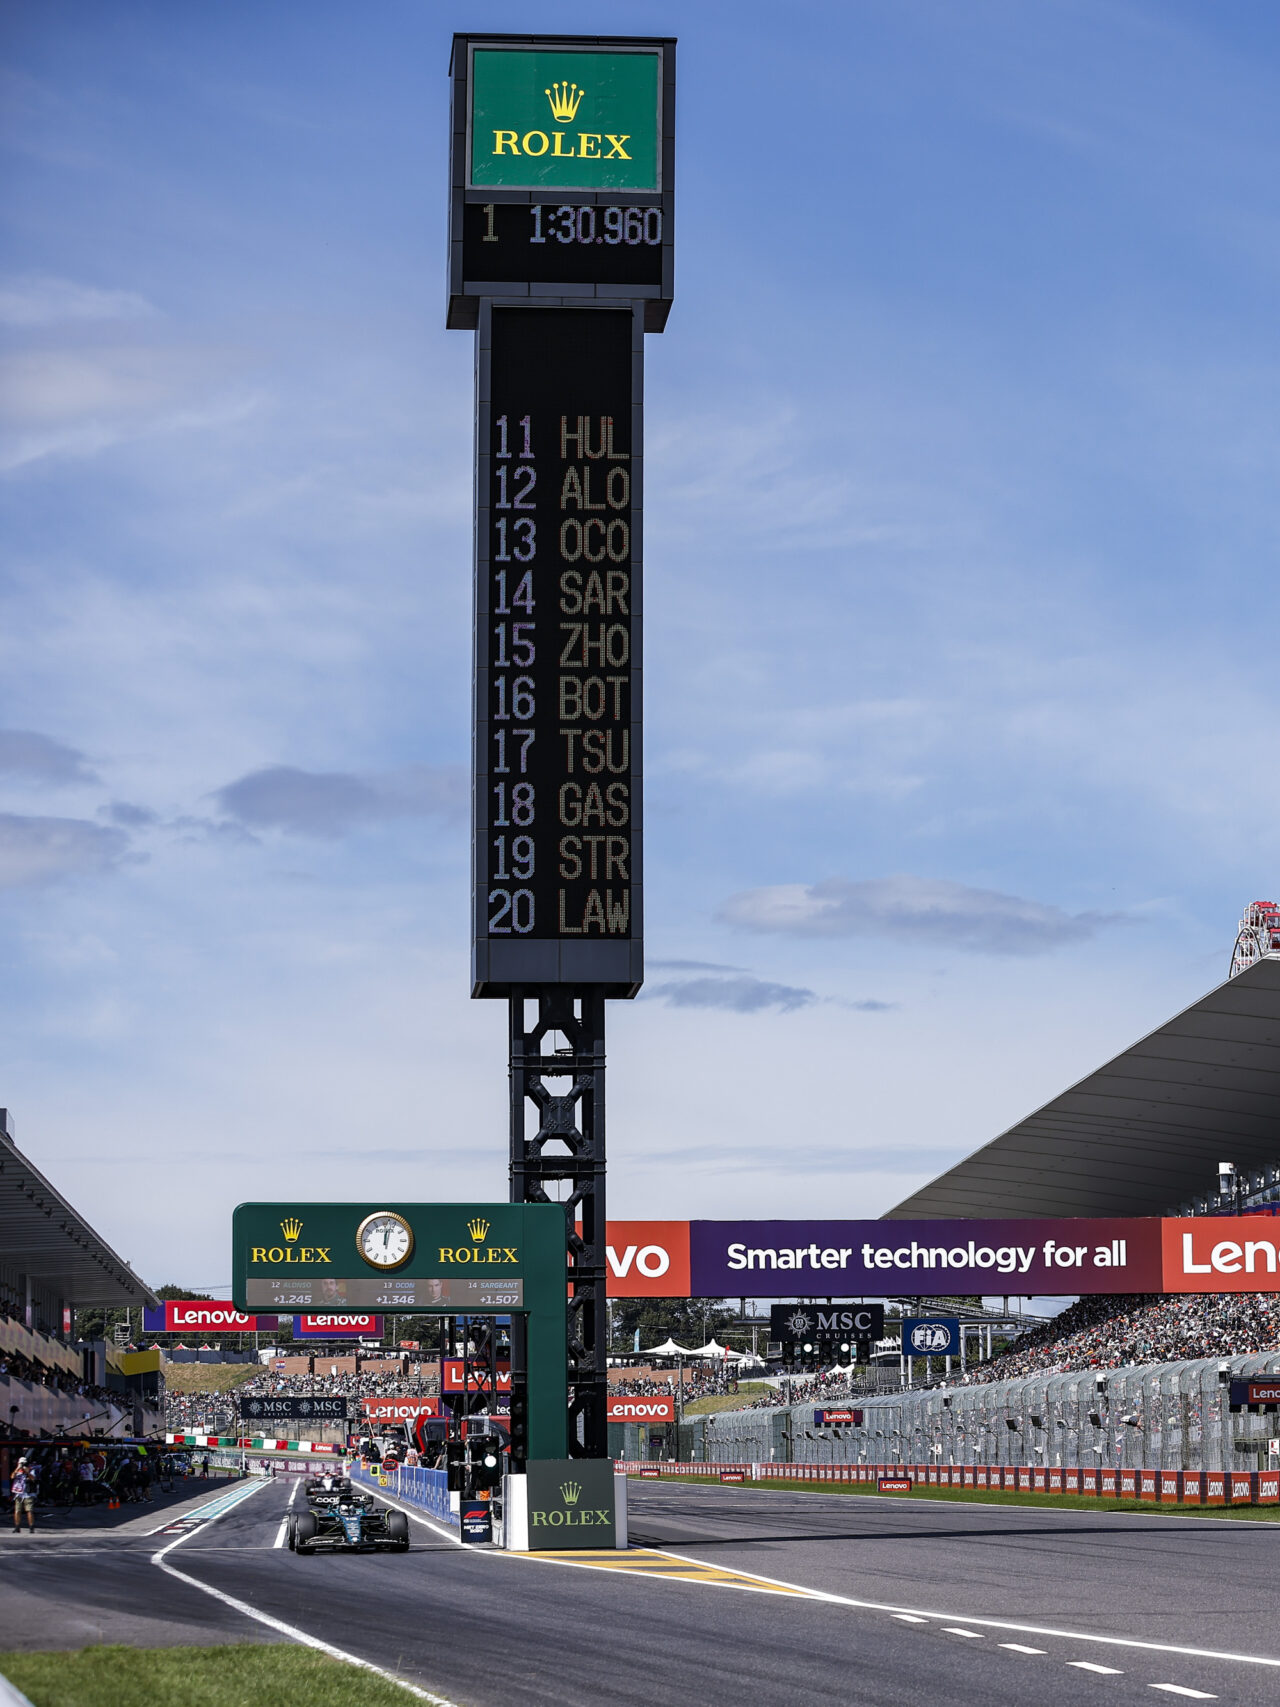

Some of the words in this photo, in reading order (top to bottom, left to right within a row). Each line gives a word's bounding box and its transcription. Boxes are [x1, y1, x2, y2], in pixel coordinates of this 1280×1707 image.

[492, 130, 632, 159] ROLEX
[482, 204, 498, 242] 1
[530, 205, 662, 245] 1:30.960
[496, 415, 535, 458] 11
[560, 415, 630, 459] HUL
[495, 464, 537, 509] 12
[560, 466, 630, 510] ALO
[495, 517, 536, 562] 13
[560, 518, 629, 562] OCO
[494, 569, 536, 615] 14
[560, 570, 629, 615] SAR
[494, 622, 536, 667] 15
[560, 622, 629, 668] ZHO
[494, 675, 535, 720] 16
[559, 675, 629, 721] BOT
[494, 729, 535, 773] 17
[559, 729, 629, 773] TSU
[494, 782, 535, 827] 18
[559, 782, 629, 827] GAS
[494, 835, 535, 880] 19
[559, 835, 629, 880] STR
[488, 888, 535, 933] 20
[559, 888, 629, 933] LAW
[251, 1248, 332, 1263] ROLEX
[439, 1248, 519, 1263] ROLEX
[605, 1245, 670, 1278] vo
[727, 1243, 852, 1270] Smarter
[861, 1241, 1036, 1273] technology
[1043, 1240, 1087, 1268] for
[1093, 1240, 1127, 1267] all
[273, 1295, 312, 1304] +1.245
[376, 1295, 415, 1304] +1.346
[479, 1295, 519, 1304] +1.507
[173, 1307, 249, 1324] Lenovo
[307, 1315, 370, 1326] Lenovo
[816, 1312, 872, 1330] MSC
[263, 1401, 292, 1412] MSC
[313, 1401, 342, 1411] MSC
[366, 1403, 432, 1418] Lenovo
[1260, 1478, 1278, 1497] Lenovo
[531, 1510, 611, 1526] ROLEX
